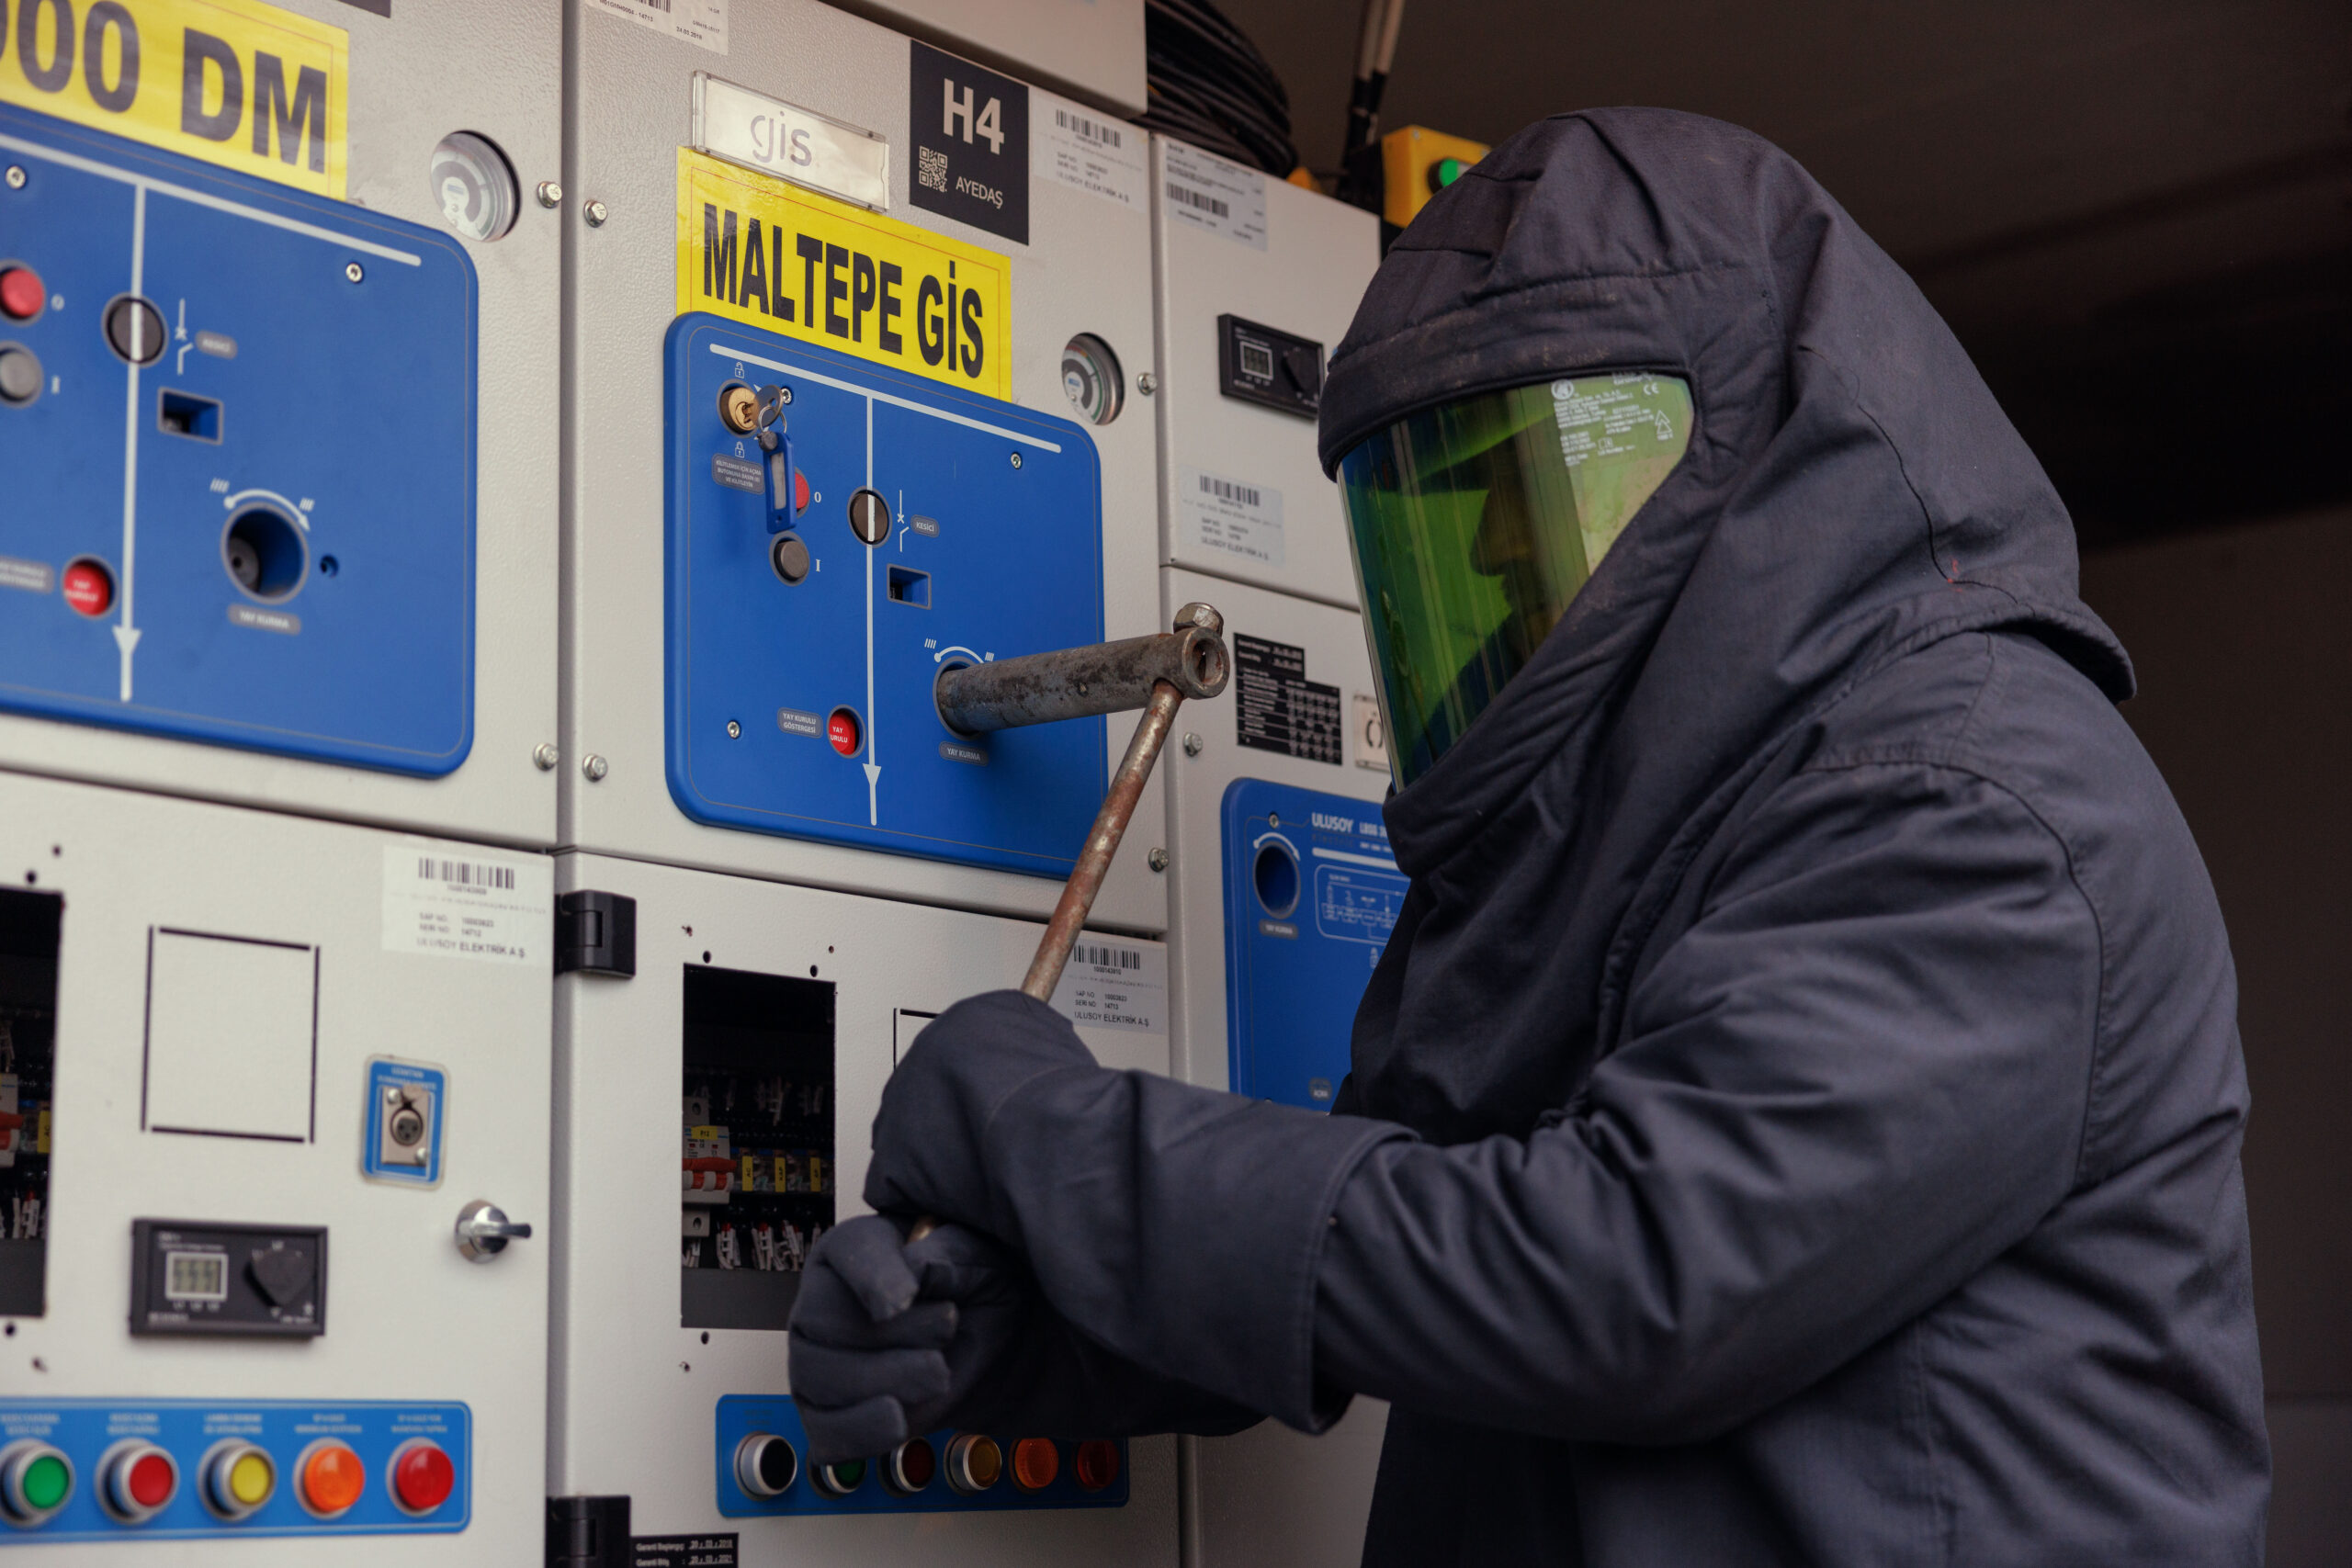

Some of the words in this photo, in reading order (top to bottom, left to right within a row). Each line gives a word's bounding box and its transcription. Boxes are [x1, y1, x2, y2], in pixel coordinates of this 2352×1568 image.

[0, 0, 141, 113] 00
[181, 27, 326, 175] DM
[944, 77, 1004, 155] H4
[750, 111, 812, 166] gis
[956, 176, 1003, 209] AYEDAŞ
[704, 202, 902, 355] MALTEPE
[917, 260, 983, 378] GİS
[814, 491, 821, 503] 0
[916, 521, 934, 532] KESİCİ
[795, 715, 816, 725] KURULU
[784, 722, 816, 734] GÖSTERGESİ
[830, 734, 848, 743] URULU
[947, 747, 958, 756] YAY
[959, 749, 981, 761] KURMA
[1312, 812, 1354, 833] ULUSOY
[1074, 1011, 1102, 1021] ULUSOY
[1103, 1013, 1136, 1025] ELEKTRİK
